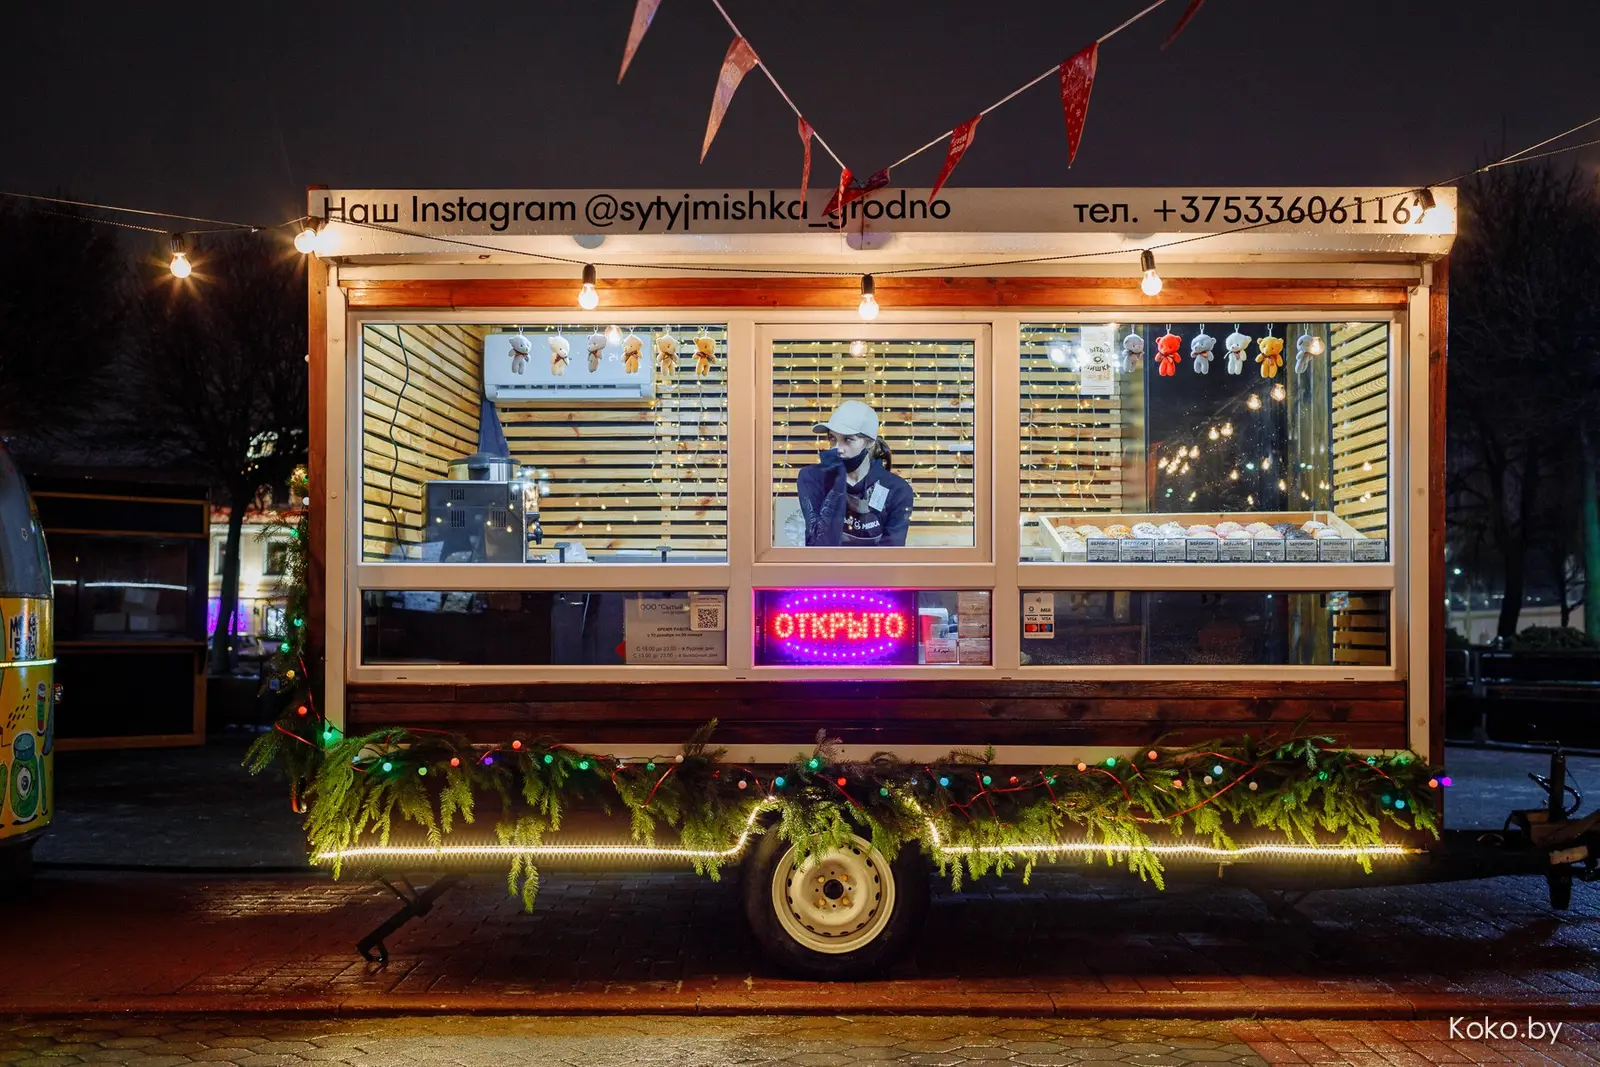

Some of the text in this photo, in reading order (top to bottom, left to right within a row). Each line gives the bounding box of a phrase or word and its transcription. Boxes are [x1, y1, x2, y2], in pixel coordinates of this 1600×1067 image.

[324, 189, 951, 231] Наш Instagram @sytyjmishka_grodno
[1073, 203, 1138, 223] тел.
[774, 612, 905, 640] ОТКРЫТО
